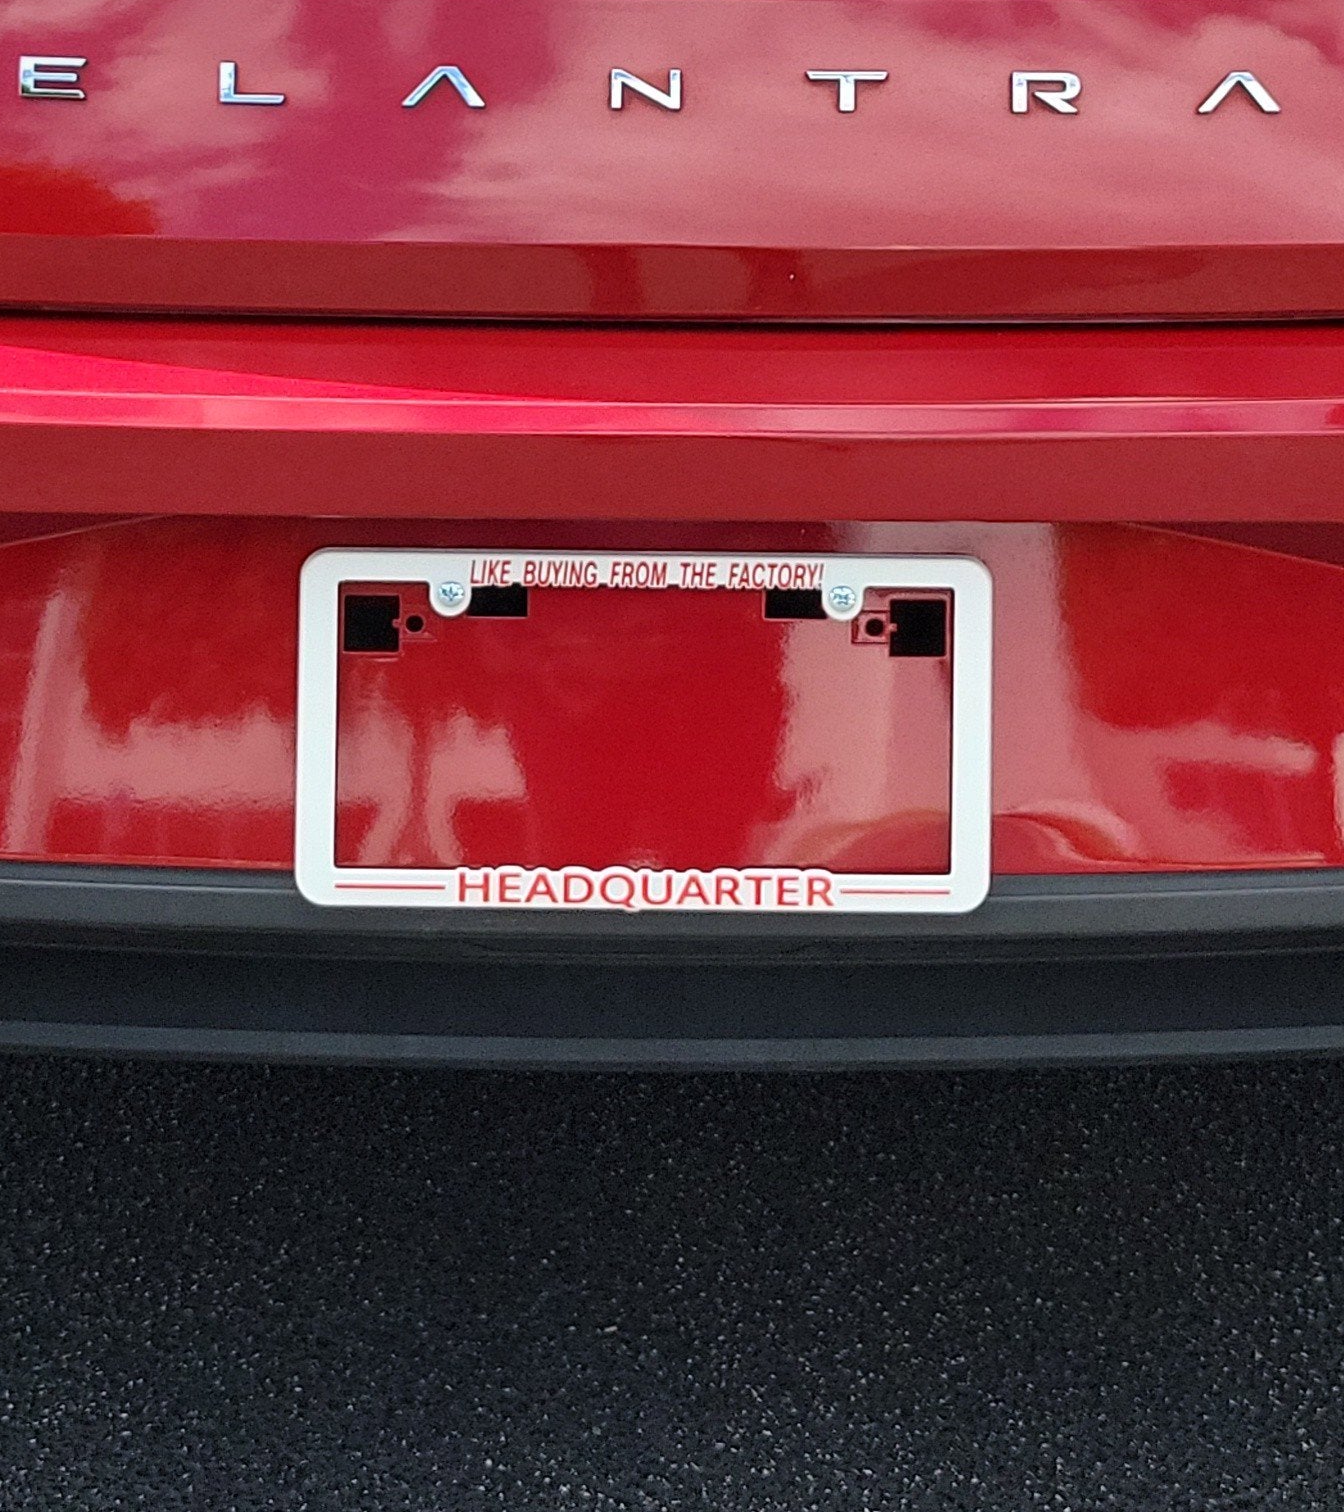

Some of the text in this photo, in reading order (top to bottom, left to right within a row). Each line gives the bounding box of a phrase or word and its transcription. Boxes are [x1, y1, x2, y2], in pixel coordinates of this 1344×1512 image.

[19, 55, 1281, 114] ELANTRA
[469, 560, 825, 590] LIKE BUYING FROM THE FACTORY!
[457, 872, 835, 909] HEADQUARTER
